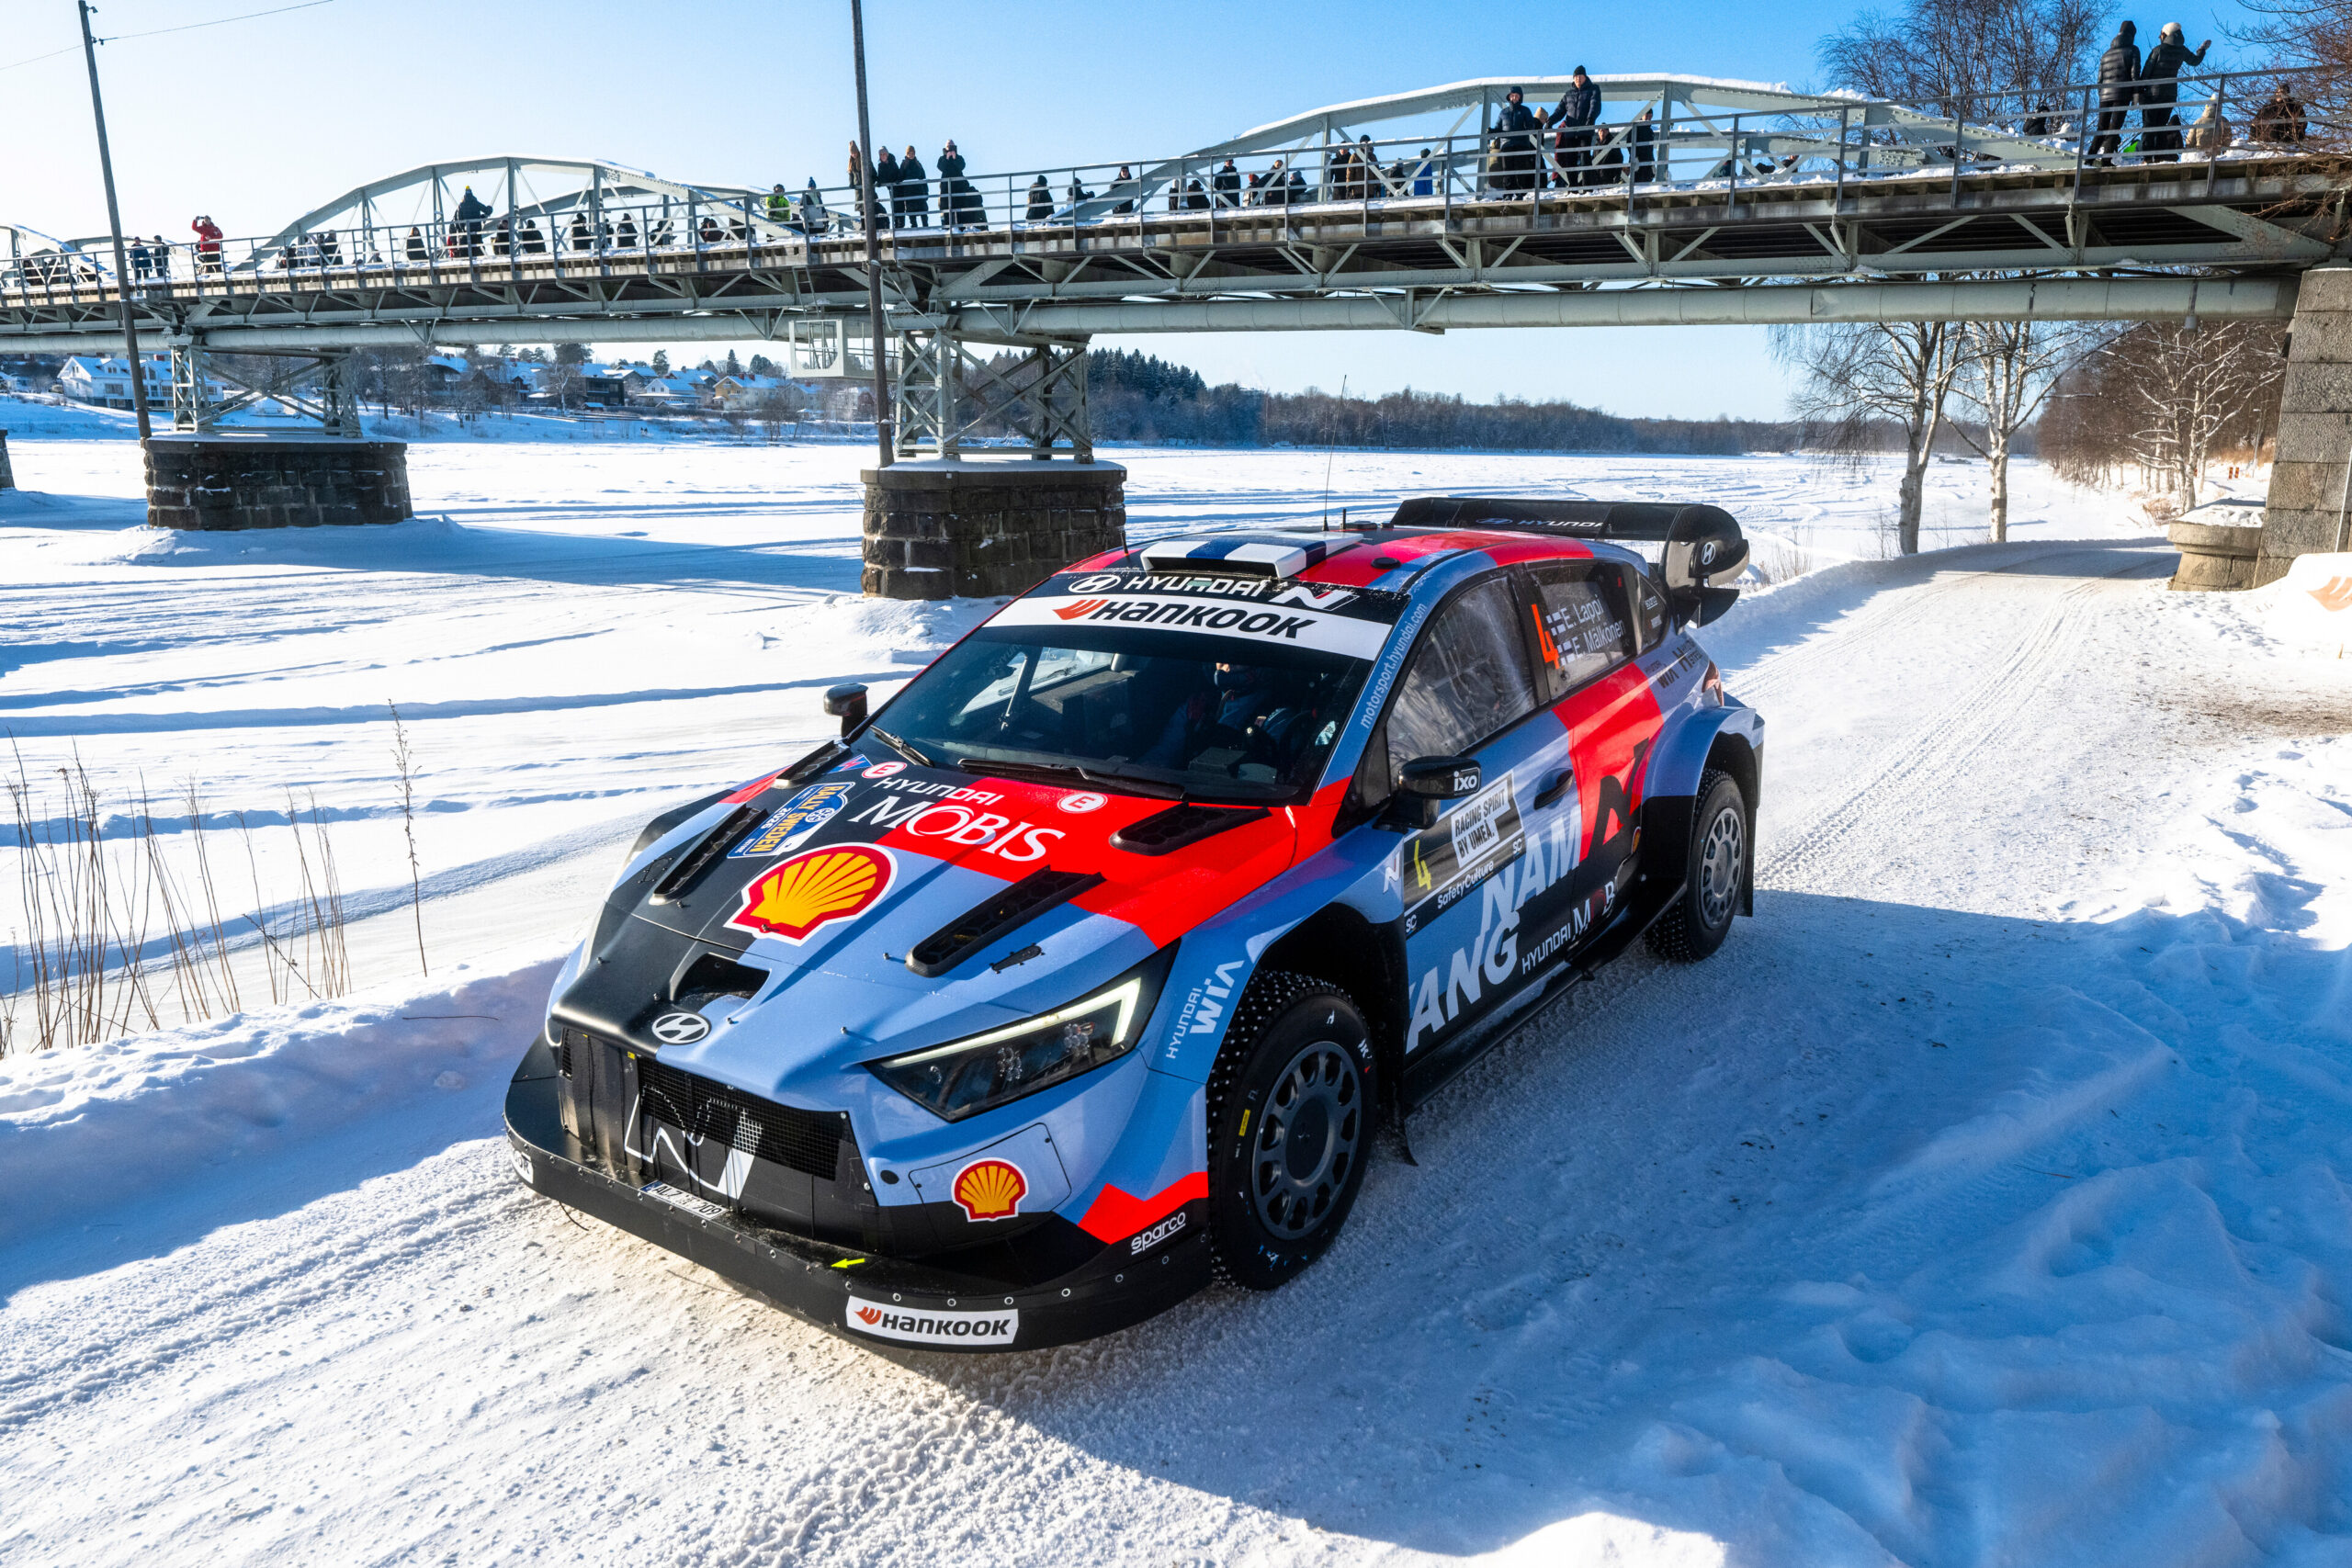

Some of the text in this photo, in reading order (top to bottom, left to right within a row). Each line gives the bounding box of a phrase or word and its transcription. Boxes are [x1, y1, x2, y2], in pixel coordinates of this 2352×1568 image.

[1517, 520, 1605, 528] HYUNDA
[1123, 576, 1272, 597] HYUNDAI
[1560, 593, 1604, 629] E. Lappi
[1531, 604, 1560, 670] 4
[1360, 603, 1428, 729] motorsport.hyundai.com
[798, 785, 844, 810] RALLY
[875, 777, 1004, 806] HYUNDAI
[1453, 772, 1477, 791] ixo
[750, 811, 806, 852] SWEDEN
[761, 807, 792, 829] 2026
[847, 795, 1066, 862] MOBIS
[1455, 789, 1506, 838] RACING SPIRIT
[1413, 839, 1431, 891] 4
[1457, 836, 1469, 858] BY
[1512, 838, 1522, 854] SC
[1437, 860, 1494, 909] SafetyCulture
[1406, 914, 1418, 933] SC
[1521, 922, 1572, 975] HYUNDAI
[1406, 915, 1521, 1055] ANG
[1166, 987, 1203, 1059] HYUNDAI
[1131, 1212, 1186, 1255] sparco
